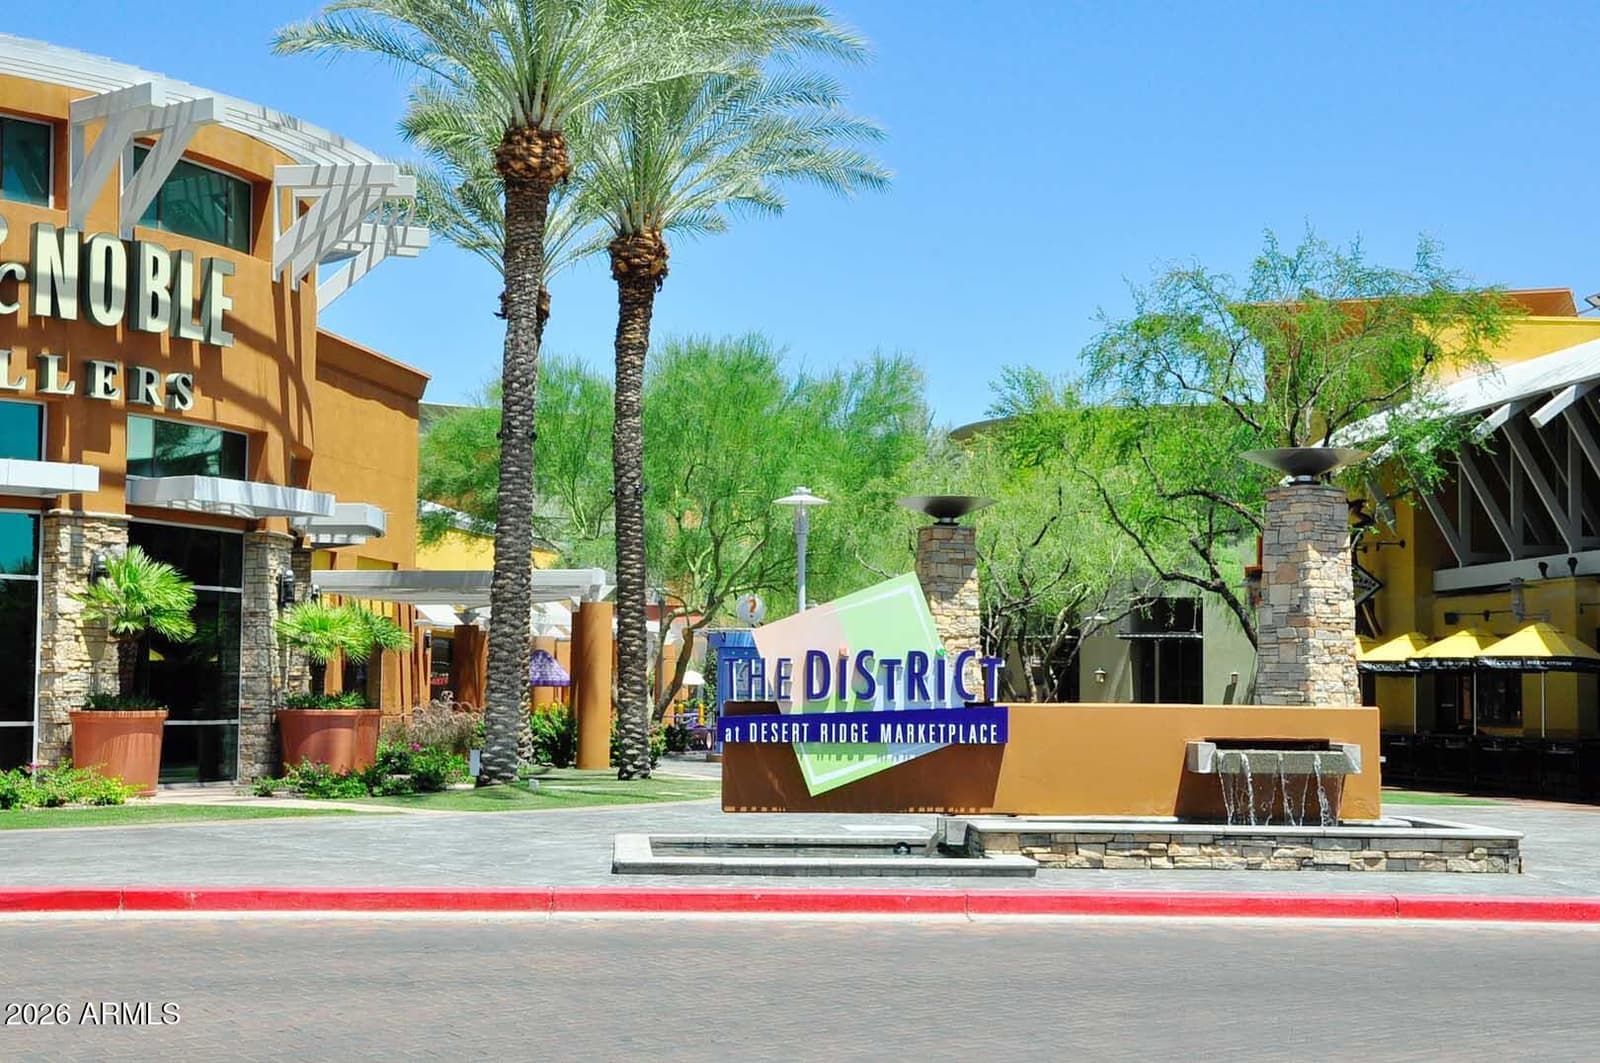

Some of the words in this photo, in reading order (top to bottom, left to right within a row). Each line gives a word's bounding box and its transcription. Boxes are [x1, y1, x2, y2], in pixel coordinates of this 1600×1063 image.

[31, 222, 235, 348] NOBLE
[724, 657, 794, 702] THE
[725, 726, 740, 742] at
[749, 722, 809, 743] DESERT
[820, 722, 869, 743] RIDGE
[880, 723, 998, 744] MARKETPLACE
